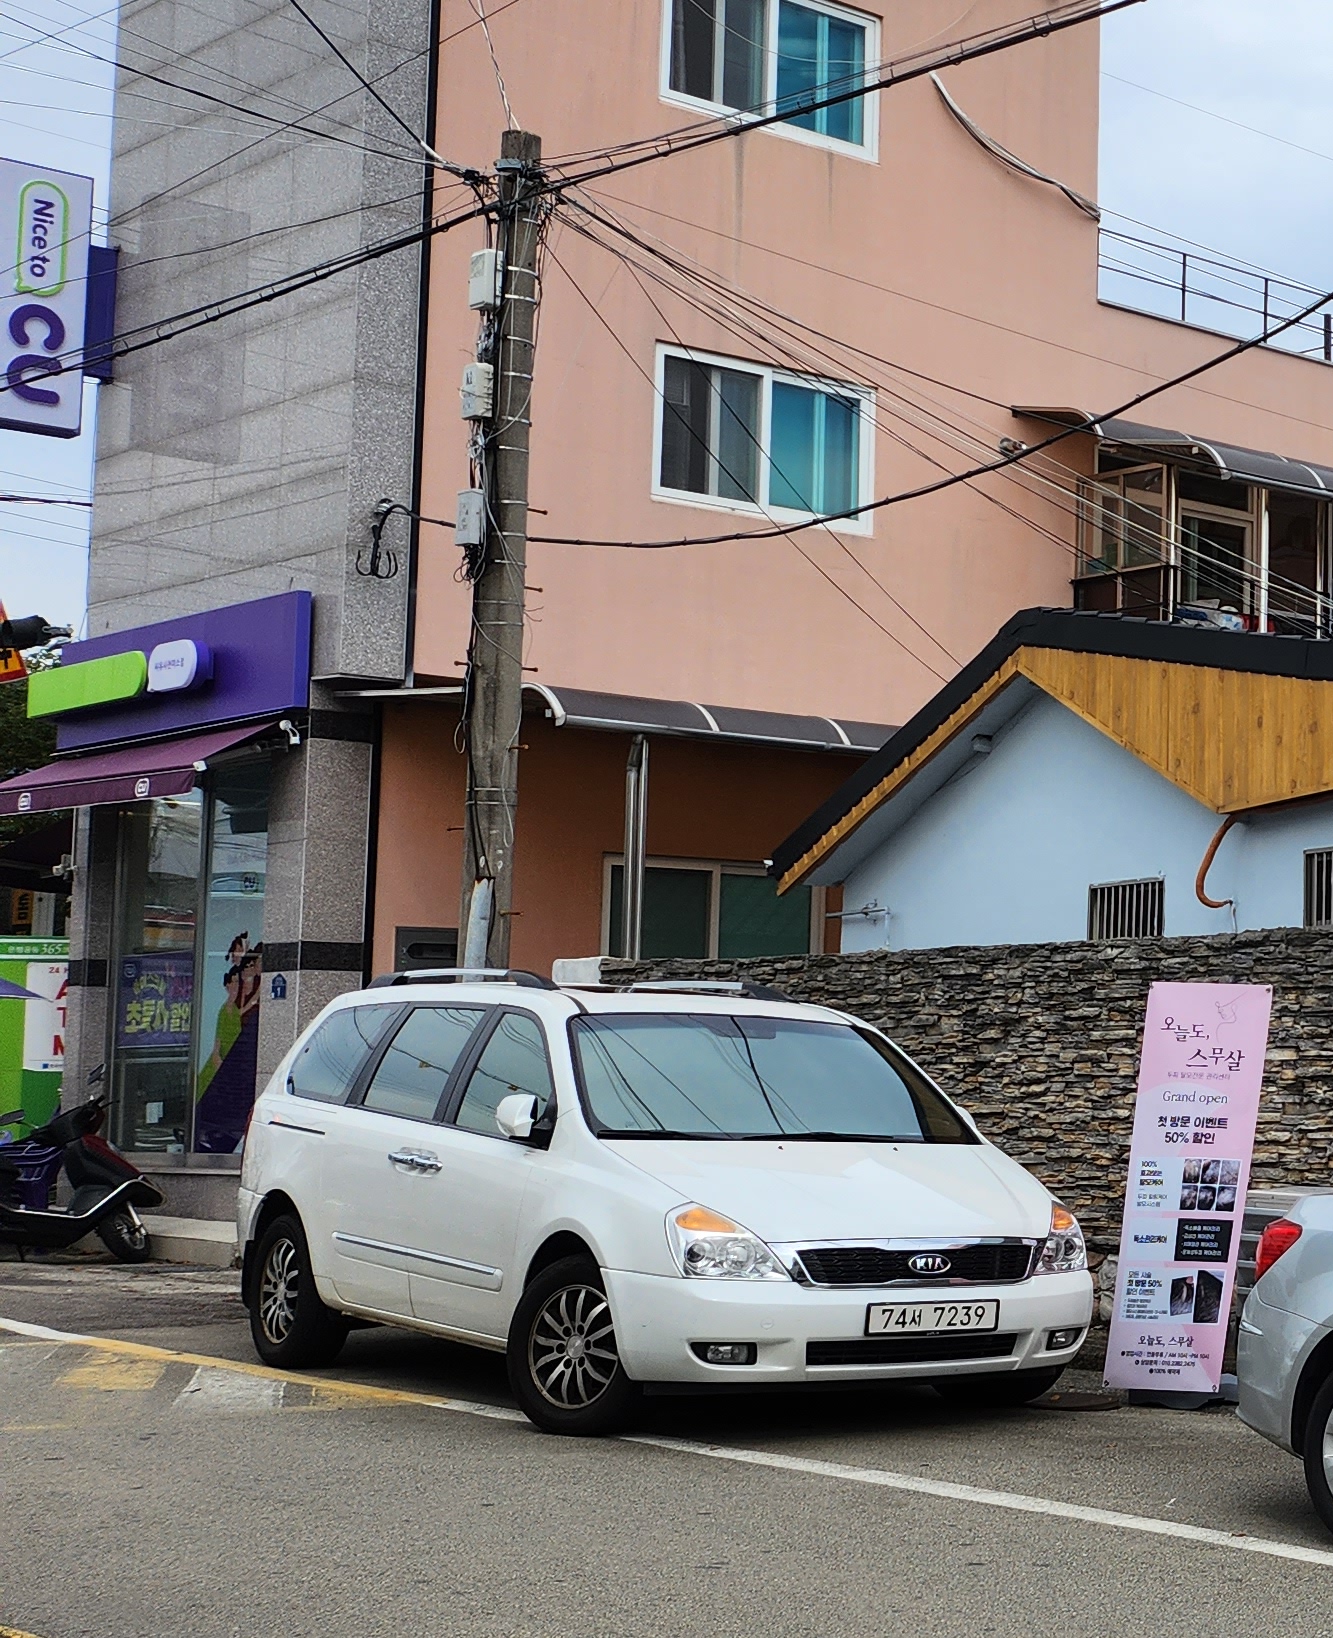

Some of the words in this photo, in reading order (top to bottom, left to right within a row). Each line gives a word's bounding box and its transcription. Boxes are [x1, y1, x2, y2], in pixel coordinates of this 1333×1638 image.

[32, 198, 55, 250] Nice
[29, 255, 51, 278] to
[7, 304, 66, 405] CU
[41, 944, 62, 954] 365
[1160, 1016, 1210, 1042] 오늘도,
[1186, 1048, 1246, 1071] 스무살
[1163, 1090, 1196, 1103] Grand
[1199, 1094, 1228, 1105] open
[1157, 1115, 1168, 1128] 첫
[1170, 1116, 1191, 1128] 방문
[1194, 1117, 1228, 1129] 이벤트
[1165, 1132, 1189, 1144] 50%
[1192, 1132, 1216, 1144] 할인
[915, 1257, 945, 1271] KIA
[1148, 1280, 1162, 1288] 50%
[881, 1308, 922, 1329] 74서
[933, 1306, 986, 1327] 7239
[1168, 1336, 1194, 1347] 스무살
